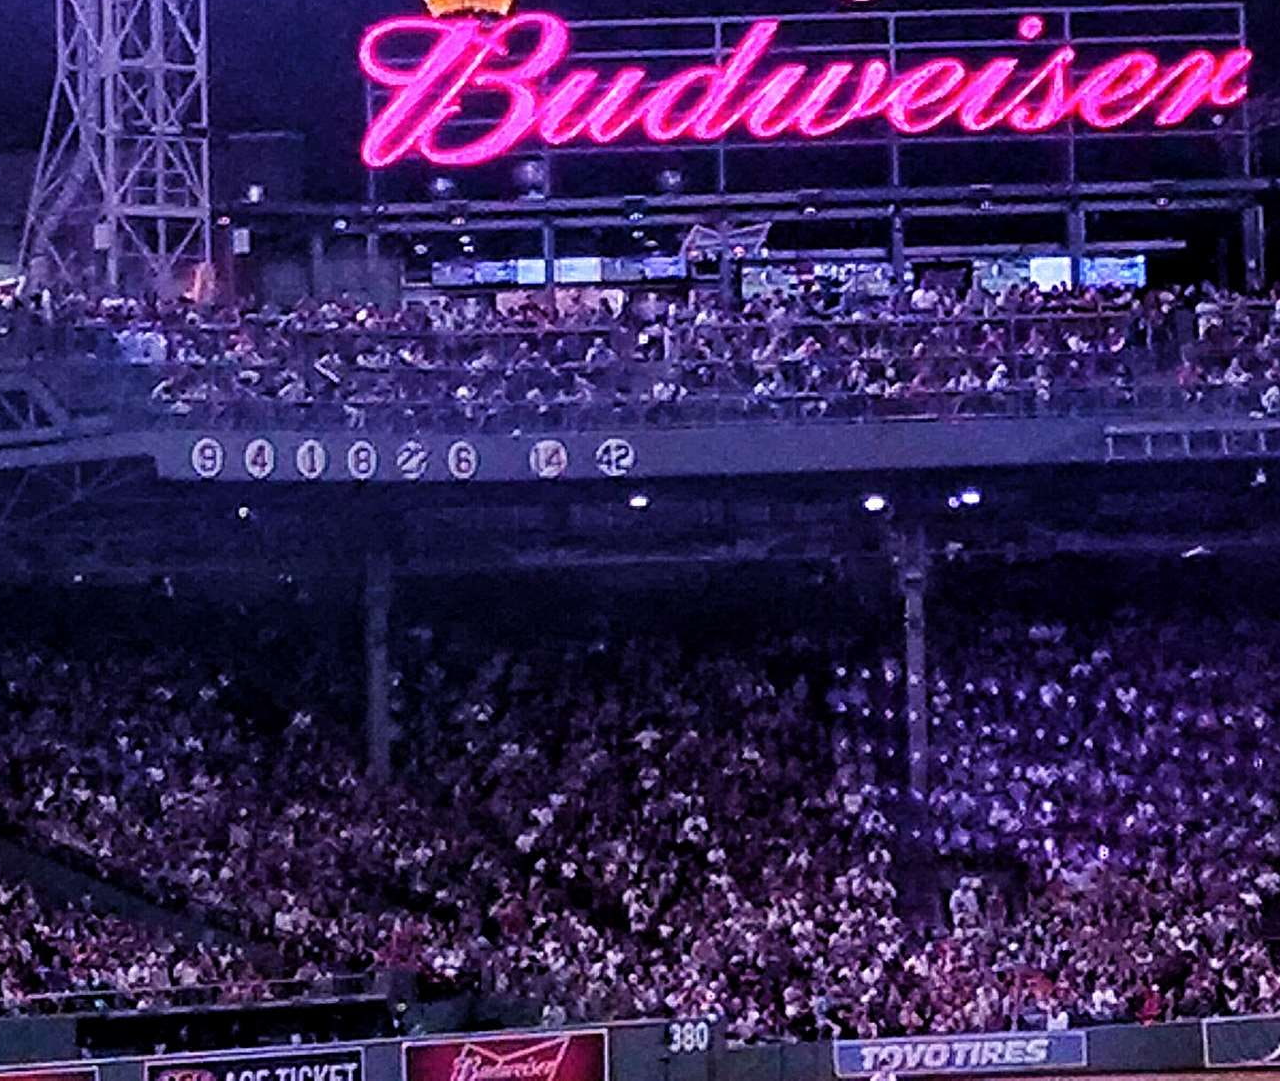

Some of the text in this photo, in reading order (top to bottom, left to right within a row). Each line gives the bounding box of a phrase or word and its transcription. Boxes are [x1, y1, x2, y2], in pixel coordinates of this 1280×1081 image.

[360, 10, 1253, 167] Budweiser
[532, 446, 564, 474] 14
[594, 443, 632, 472] 42
[670, 1021, 709, 1053] 380
[952, 1039, 1049, 1066] TIRES
